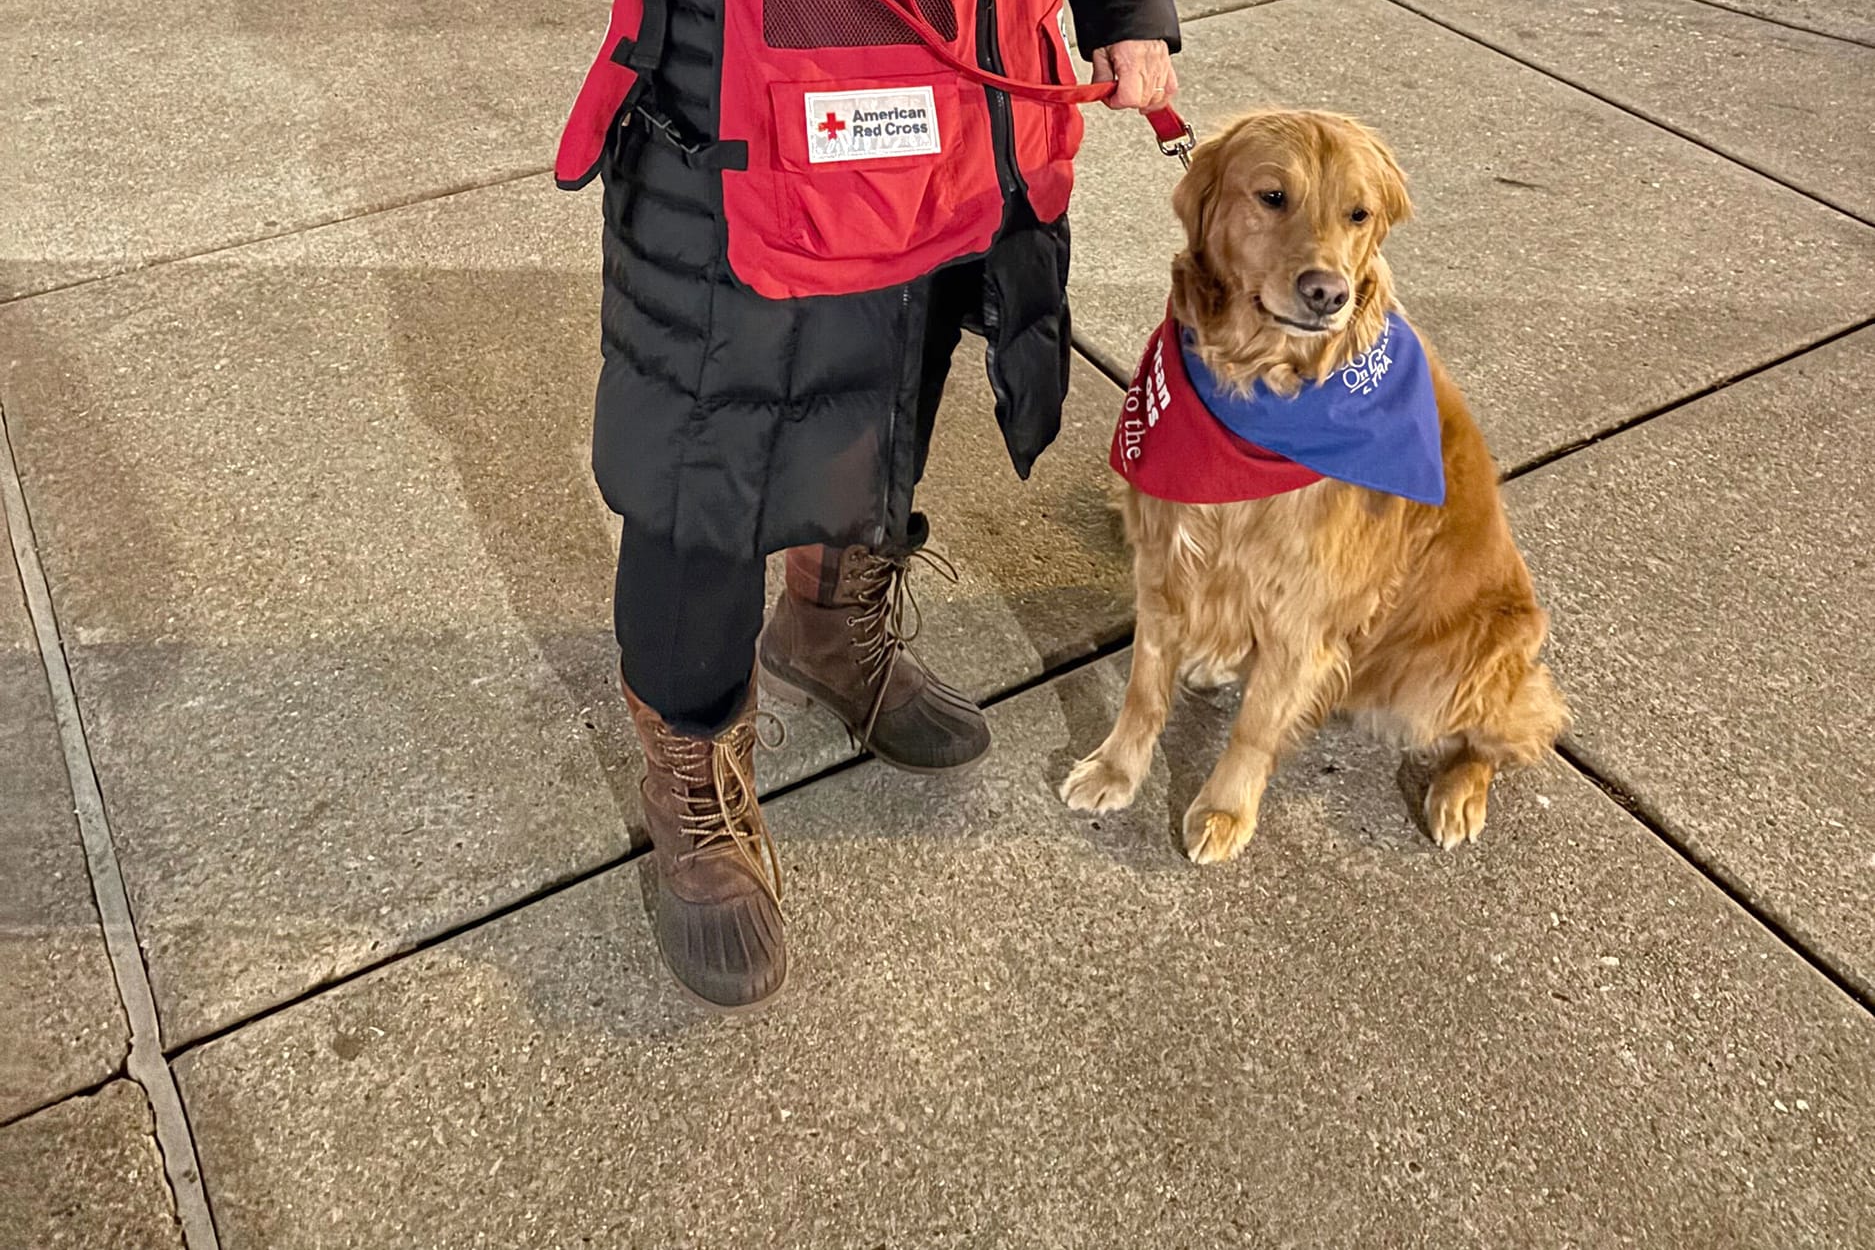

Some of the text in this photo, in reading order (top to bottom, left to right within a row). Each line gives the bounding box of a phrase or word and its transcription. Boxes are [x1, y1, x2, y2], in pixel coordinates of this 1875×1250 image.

[852, 107, 927, 123] American
[852, 122, 928, 138] Red Cross
[1125, 384, 1143, 413] to
[1124, 418, 1147, 460] the
